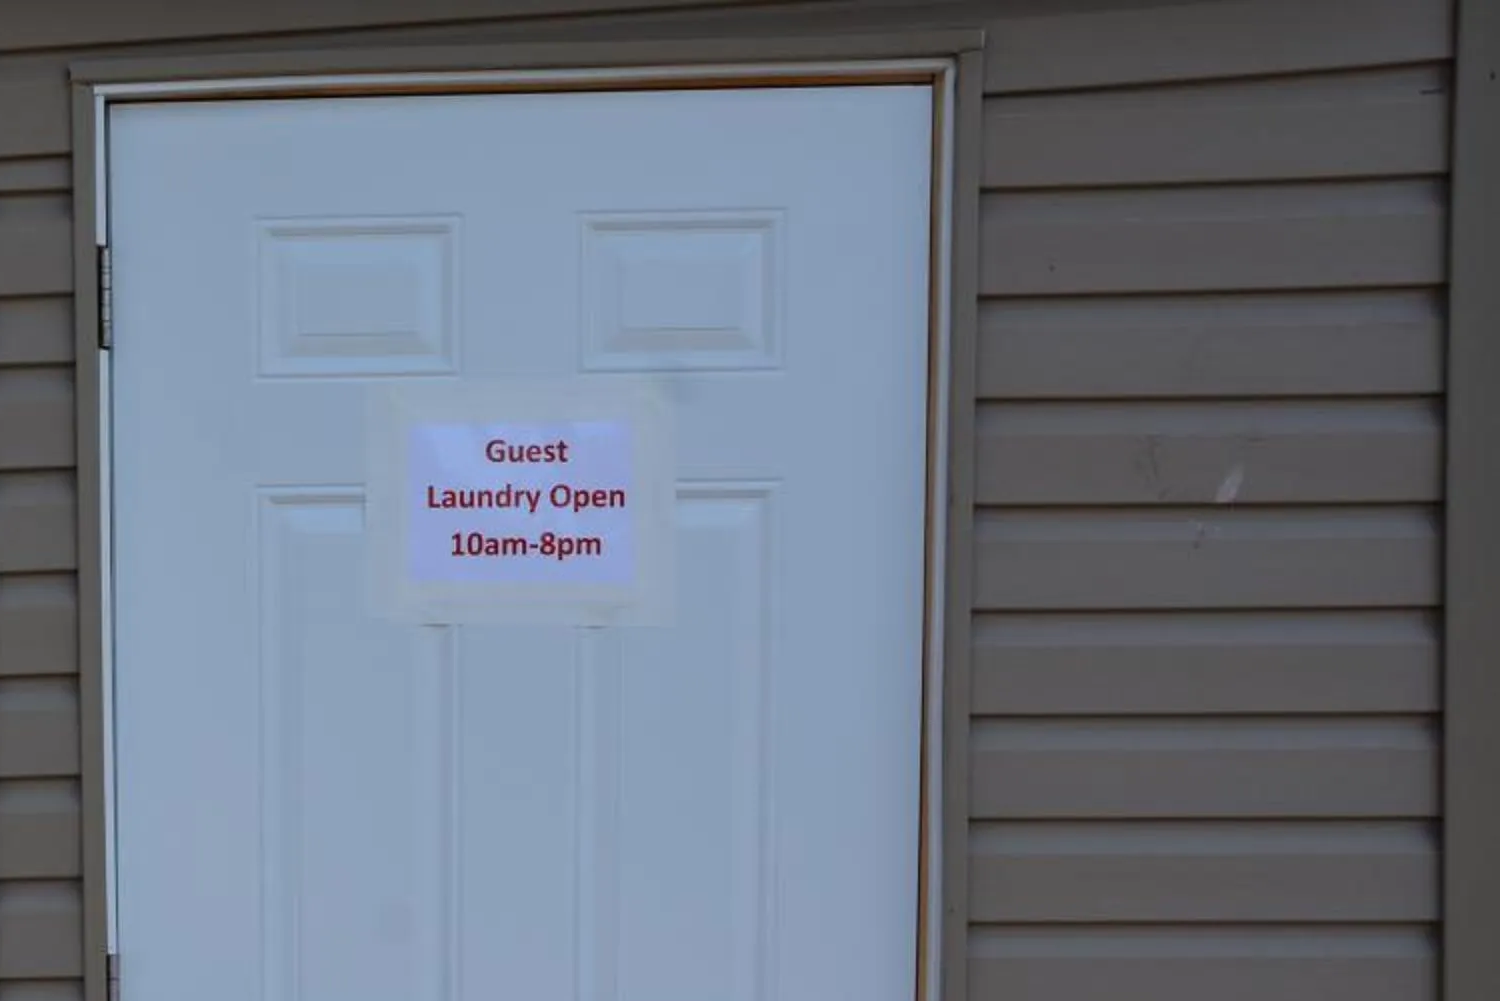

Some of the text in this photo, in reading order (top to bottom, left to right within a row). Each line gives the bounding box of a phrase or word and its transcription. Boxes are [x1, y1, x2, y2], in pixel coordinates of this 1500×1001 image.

[485, 439, 569, 463] Guest
[427, 484, 626, 513] Laundry Open
[451, 532, 602, 560] 10am-8pm
